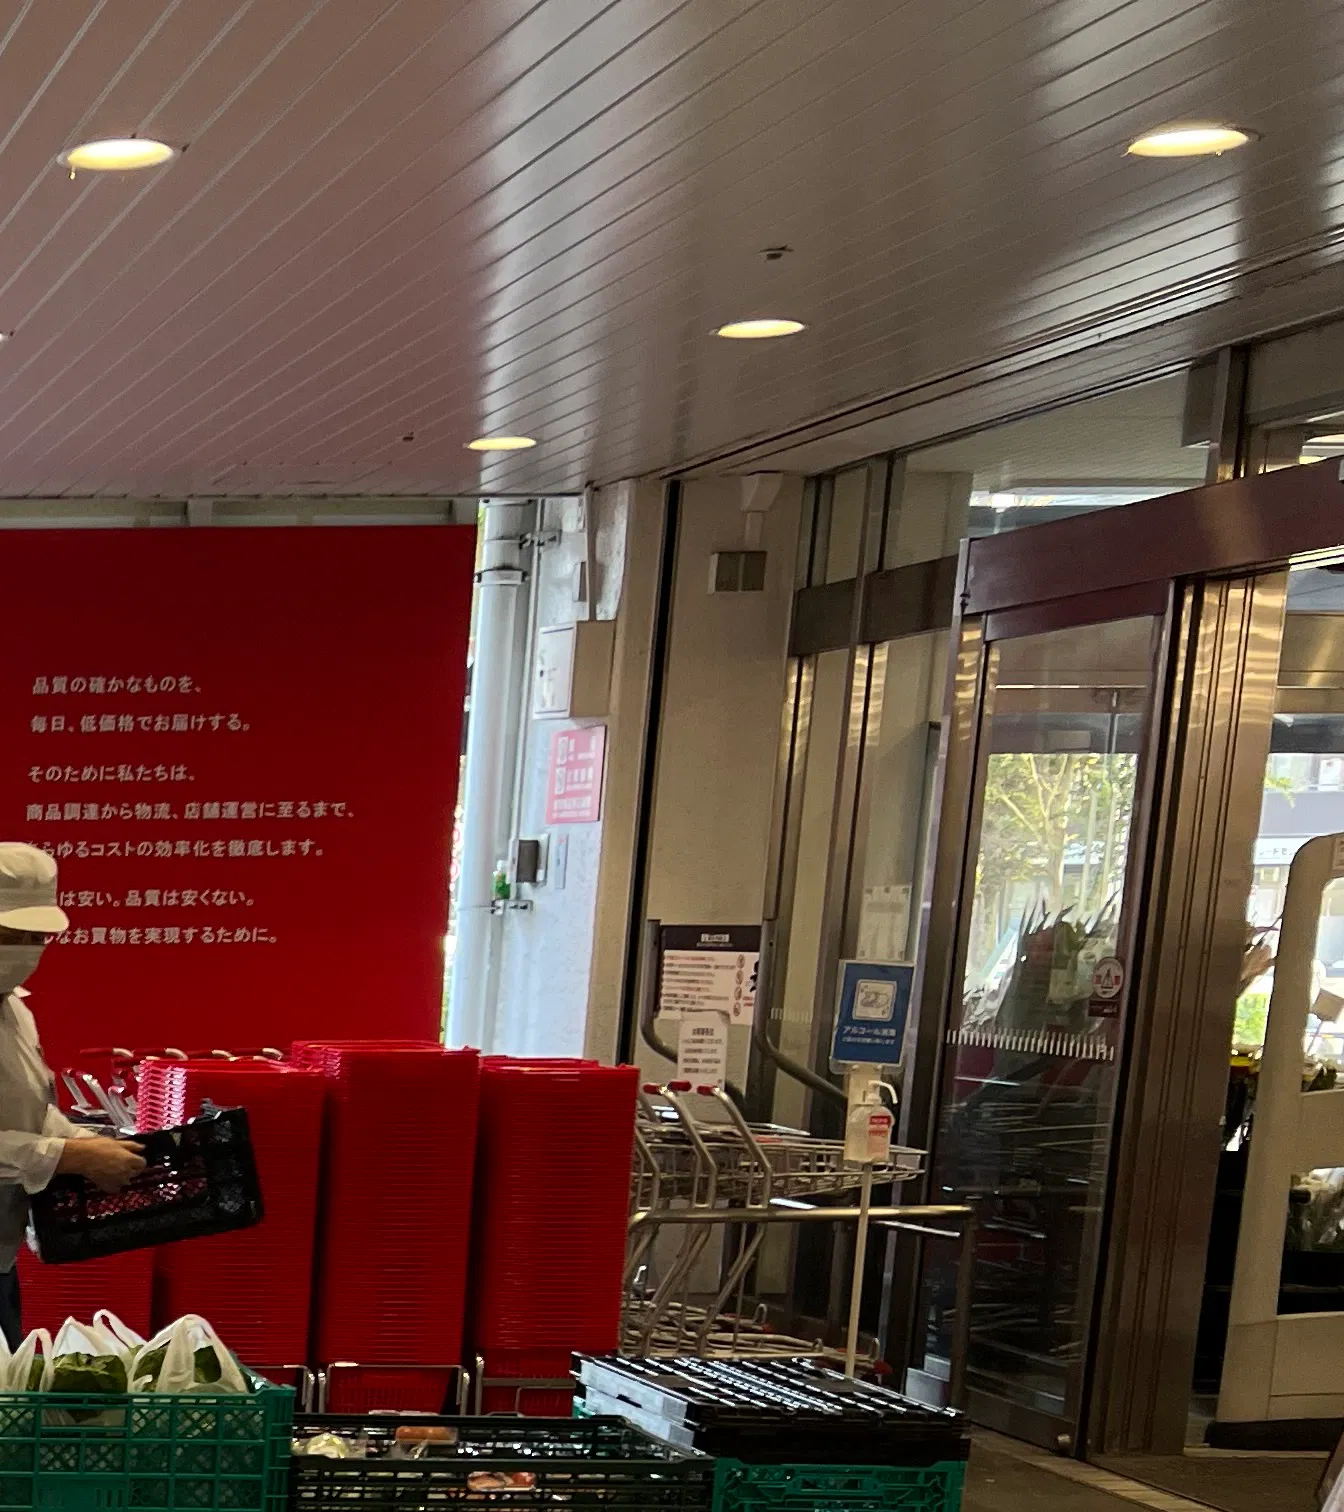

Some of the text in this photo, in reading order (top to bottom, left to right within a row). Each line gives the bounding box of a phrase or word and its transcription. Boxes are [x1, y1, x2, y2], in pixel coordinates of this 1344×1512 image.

[28, 764, 196, 783] そのために私たちは、
